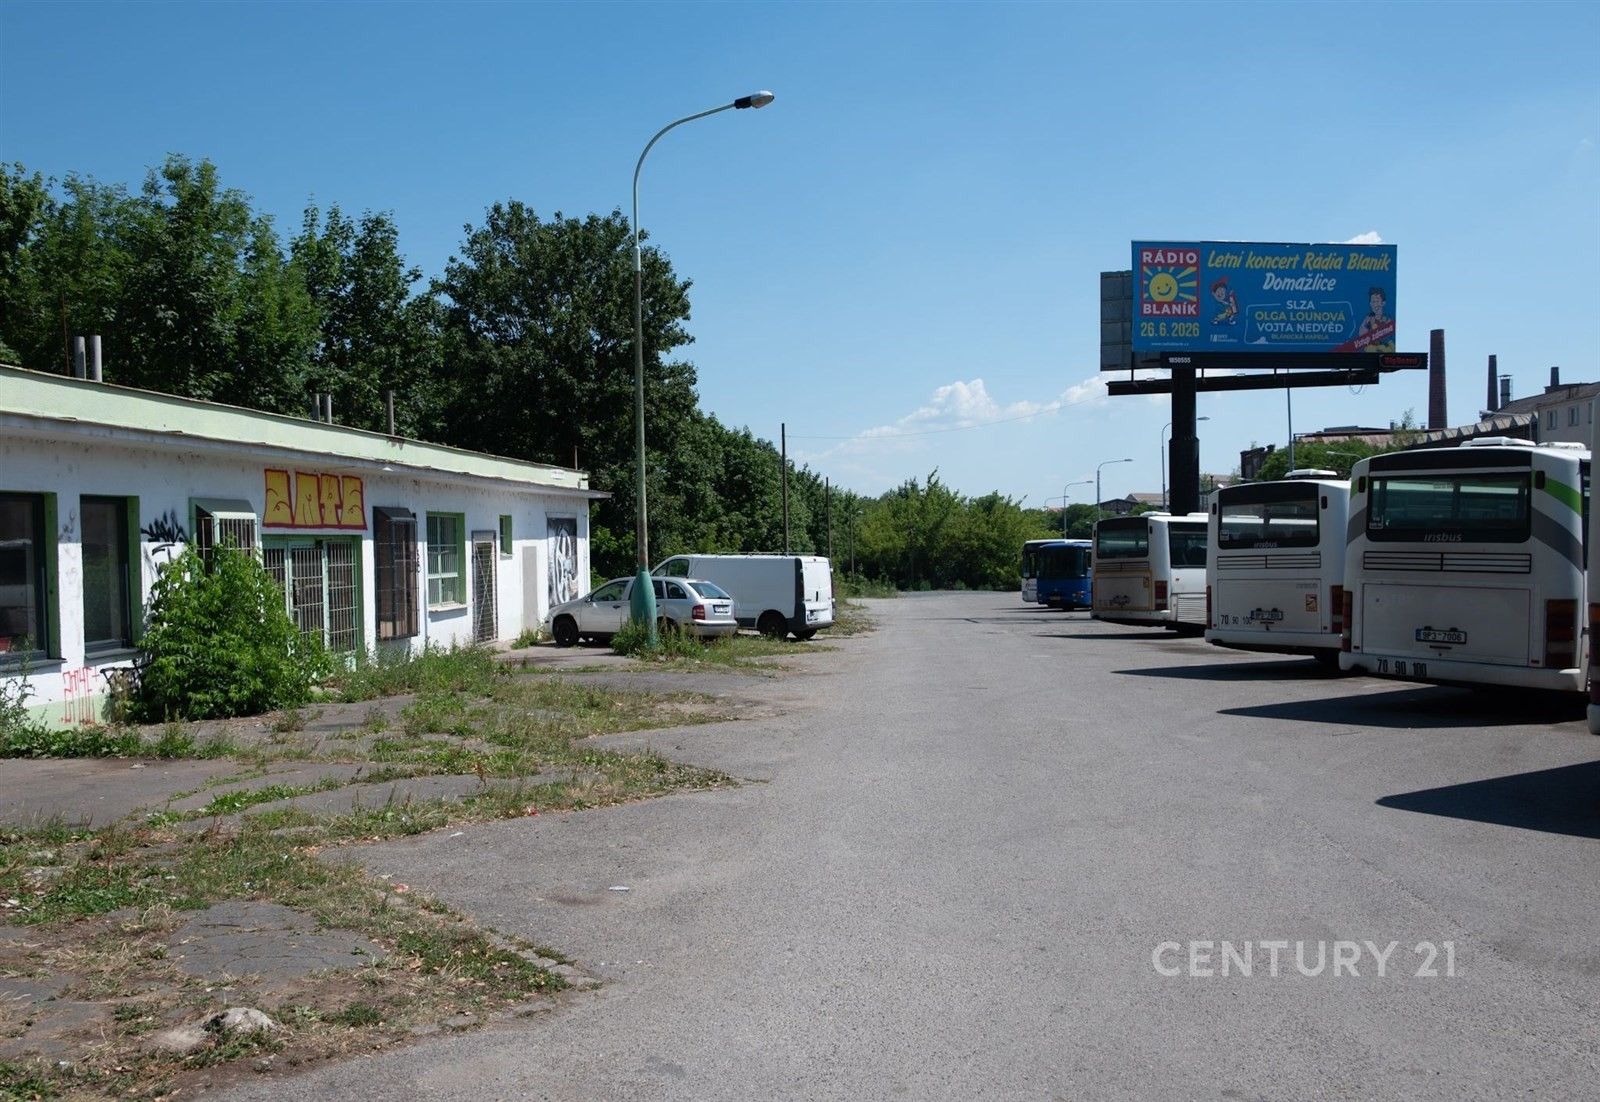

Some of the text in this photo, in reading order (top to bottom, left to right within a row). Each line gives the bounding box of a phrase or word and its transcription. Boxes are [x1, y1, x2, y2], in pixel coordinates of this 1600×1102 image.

[1142, 250, 1197, 264] RÁDIO
[1245, 252, 1300, 269] koncert
[1263, 272, 1337, 291] Domažlice
[1143, 302, 1196, 315] BLANÍK
[1286, 300, 1315, 310] SLZA
[1255, 310, 1345, 321] OLGA LOUNOVÁ
[1256, 321, 1344, 333] VOJTA NEDVĚD
[1423, 532, 1463, 543] irisbus
[1220, 615, 1229, 625] 70
[1377, 659, 1428, 678] 70 90 100
